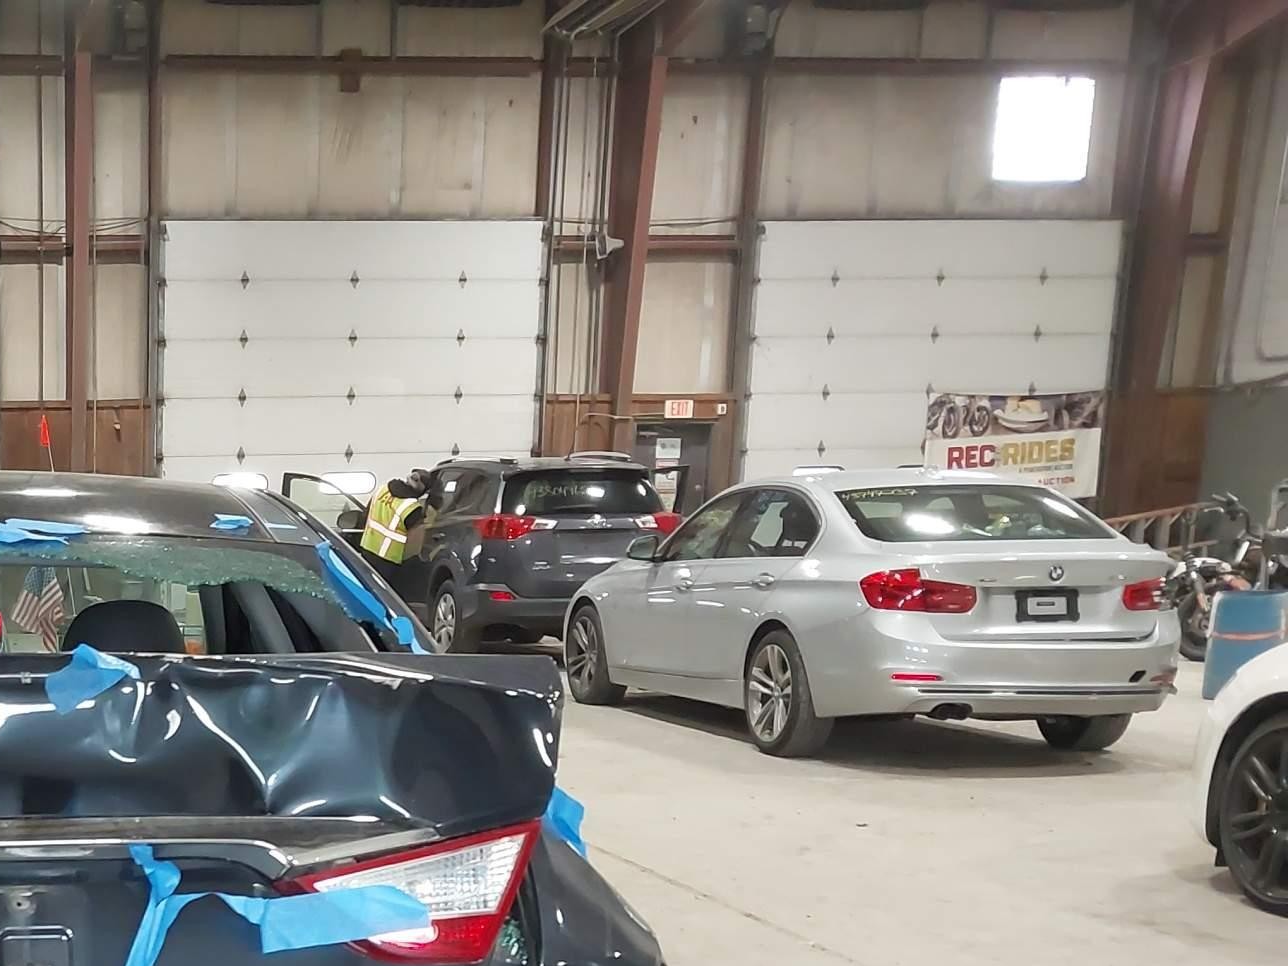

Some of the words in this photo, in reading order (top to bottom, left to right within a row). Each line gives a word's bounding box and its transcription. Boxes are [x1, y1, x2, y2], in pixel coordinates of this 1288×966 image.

[671, 401, 689, 416] EXIT
[947, 444, 997, 470] REC
[1001, 437, 1076, 466] RIDES
